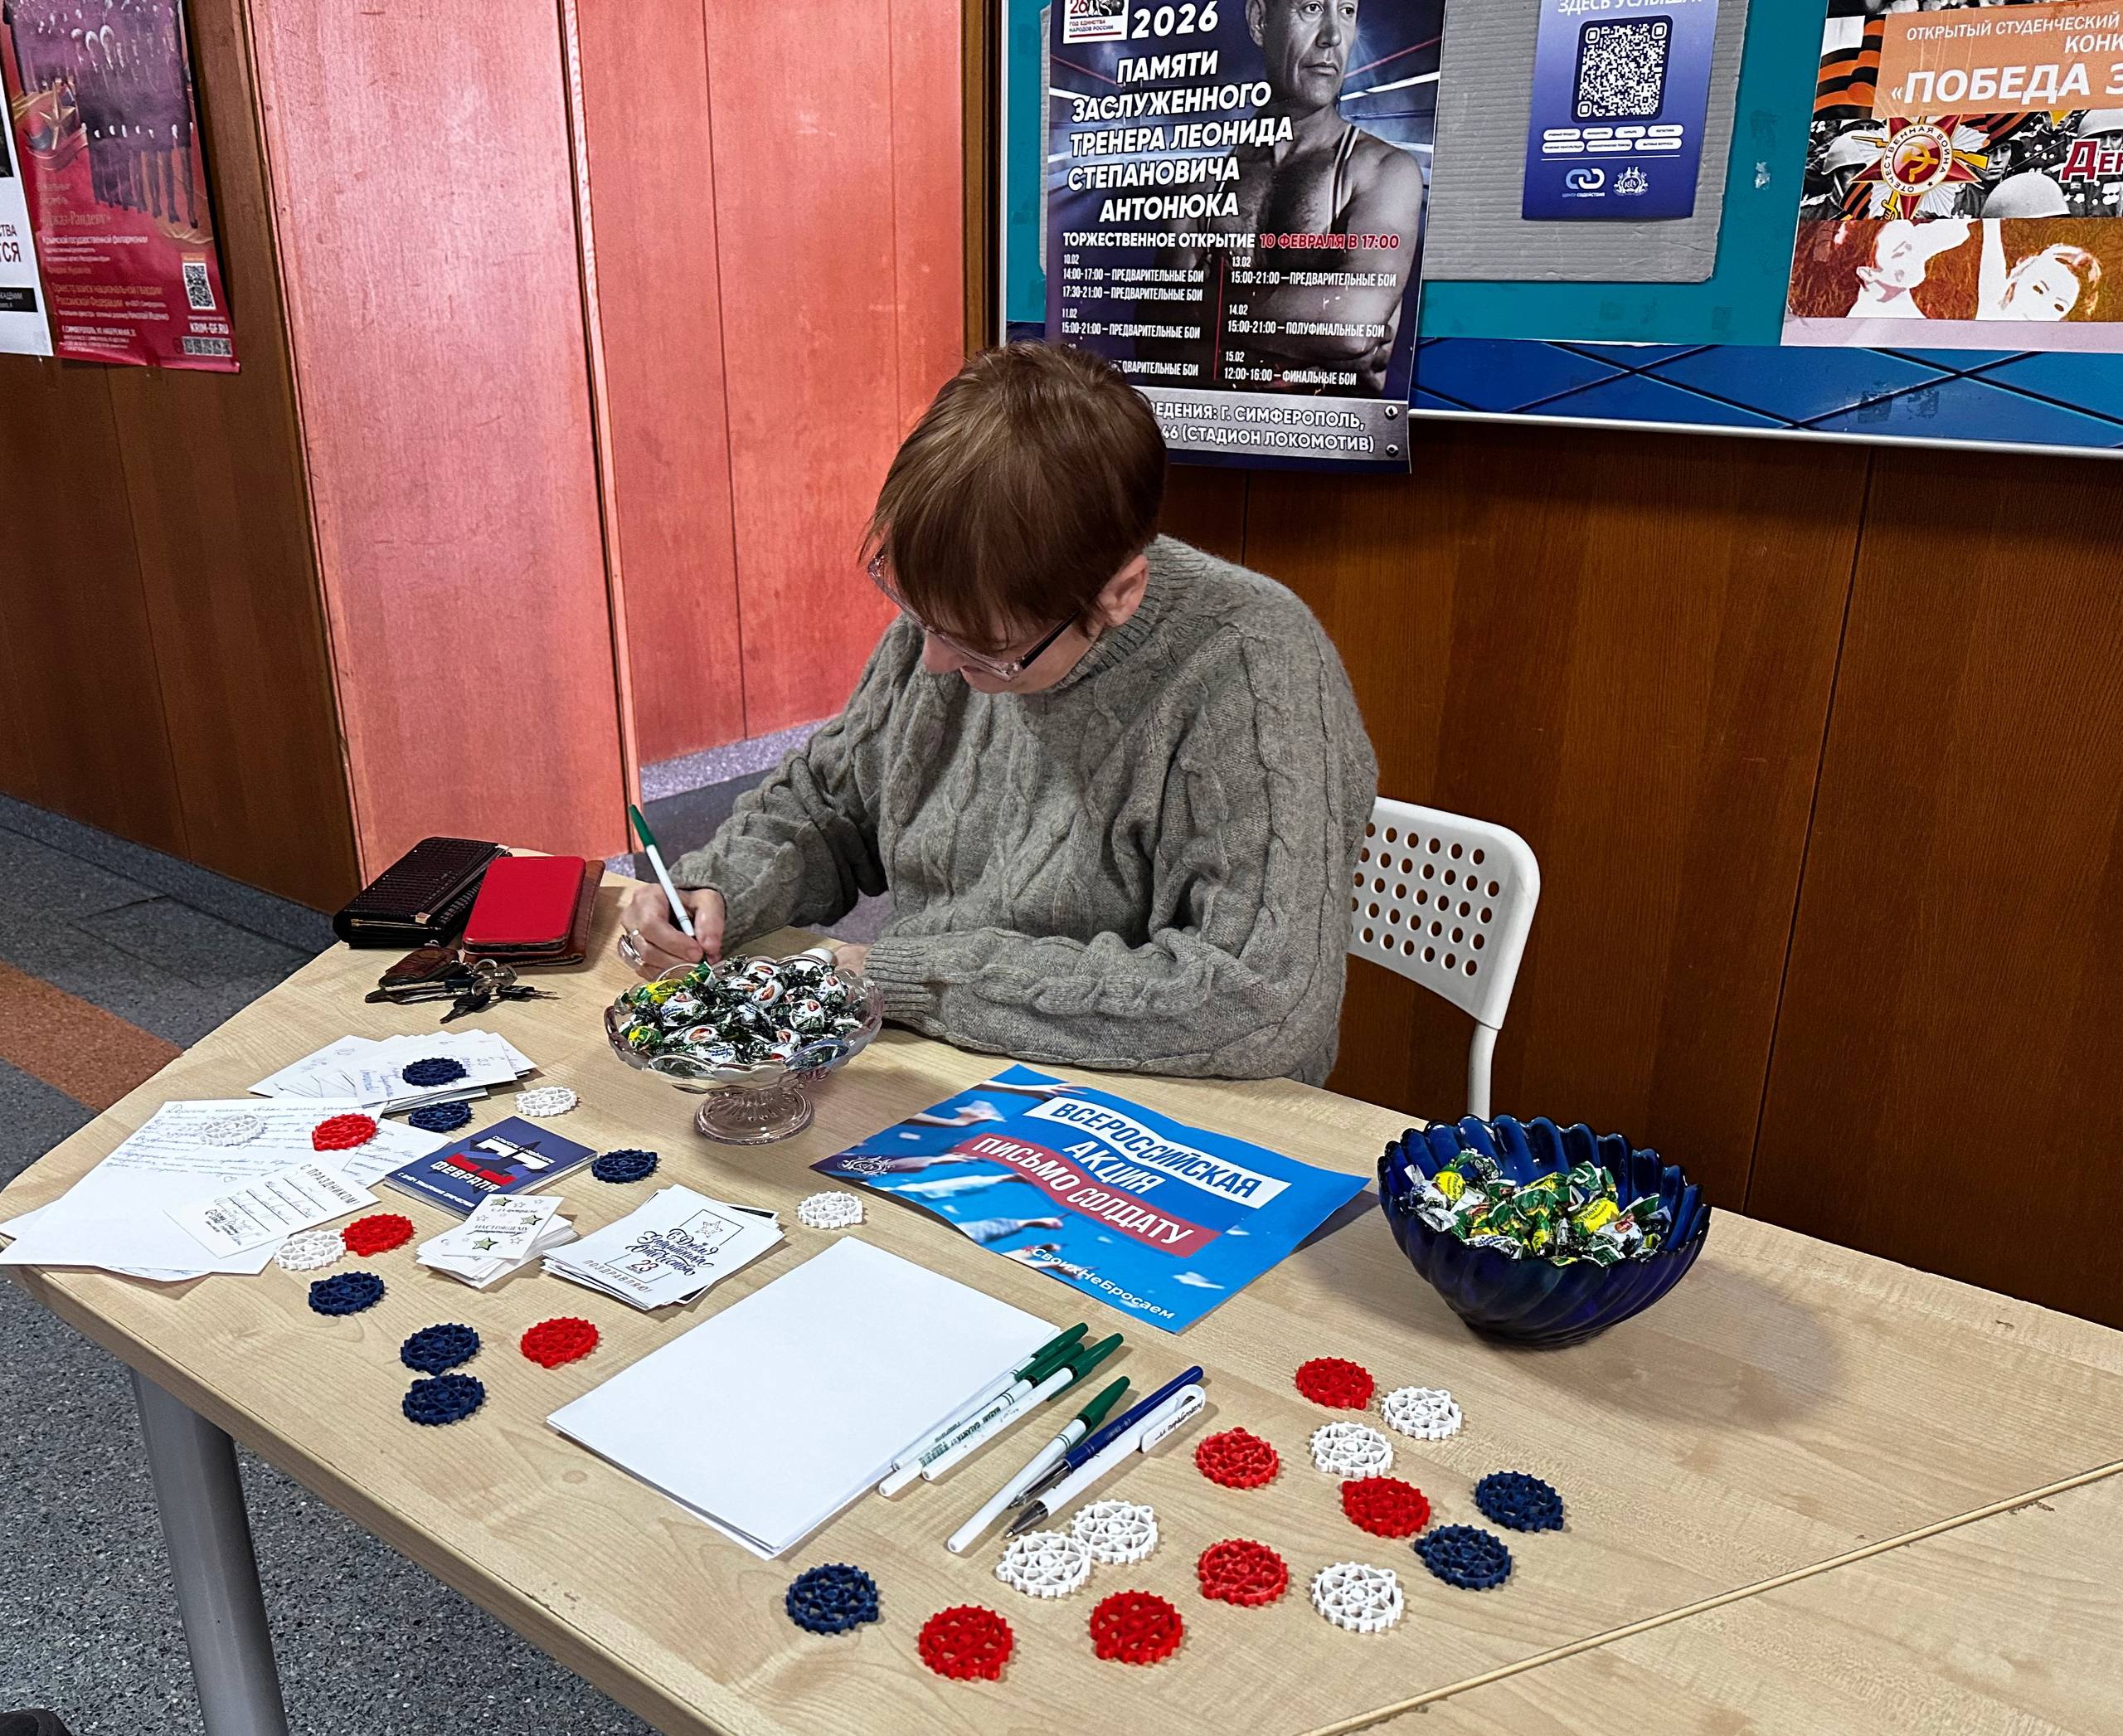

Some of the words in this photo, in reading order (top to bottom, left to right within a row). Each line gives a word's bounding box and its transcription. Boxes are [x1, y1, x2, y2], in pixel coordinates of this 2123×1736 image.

[1131, 1, 1218, 39] 2026
[1907, 22, 1991, 41] ОТКРЫТЫЙ
[1995, 12, 2121, 35] СТУДЕНЧЕСКИЙ
[1116, 50, 1218, 83] ПАМЯТИ
[1891, 63, 2091, 105] «ПОБЕДА
[1071, 81, 1271, 123] ЗАСЛУЖЕННОГО
[1070, 129, 1164, 158] ТРЕНЕРА
[1169, 117, 1294, 150] ЛЕОНИДА
[1884, 126, 1934, 192] ОТЕЧЕСТВЕННАЯ
[1067, 157, 1240, 192] СТЕПАНОВИЧА
[1098, 192, 1239, 222] АНТОНЮКА
[0, 225, 17, 237] ТВА
[1063, 232, 1176, 248] ТОРЖЕСТВЕННОЕ
[1178, 232, 1255, 249] ОТКРЫТИЕ
[1260, 234, 1275, 249] 10
[1277, 233, 1344, 250] ФЕВРАЛЯ
[1347, 235, 1358, 249] В
[1361, 234, 1400, 250] 17:00
[0, 242, 22, 262] СЯ
[1063, 254, 1079, 265] 10.02
[1232, 256, 1251, 268] 13.02
[1063, 268, 1103, 280] 14:00-17:00
[1111, 269, 1186, 283] ПРЕДВАРИТЕЛЬНЫЕ
[1188, 270, 1204, 283] БОИ
[1231, 271, 1280, 284] 15:00-21:00
[1377, 274, 1397, 287] БОИ
[1062, 286, 1103, 299] 17:30-21:00
[1110, 287, 1185, 301] ПРЕДВАРИТЕЛЬНЫЕ
[1186, 289, 1202, 301] БОИ
[1062, 308, 1077, 319] 11.02
[1229, 304, 1248, 315] 14.02
[1062, 322, 1101, 335] 15:00-21:00
[1109, 323, 1183, 338] ПРЕДВАРИТЕЛЬНЫЕ
[1184, 326, 1201, 339] БОИ
[1227, 320, 1276, 333] 15:00-21:00
[1285, 321, 1364, 337] ПОЛУФИНАЛЬНЫЕ
[1366, 324, 1385, 338] БОИ
[1226, 352, 1245, 362] 15.02
[1183, 363, 1199, 377] БОИ
[1224, 367, 1273, 381] 12:00-16:00
[1282, 371, 1337, 385] ФИНАЛЬНЫЕ
[1338, 372, 1357, 386] БОИ
[1220, 406, 1231, 421] Г.
[1234, 406, 1366, 431] СИМФЕРОПОЛЬ,
[1182, 424, 1261, 445] (СТАДИОН
[1264, 430, 1376, 453] ЛОКОМОТИВ)
[1050, 1102, 1263, 1199] ВСЕРОССИЙСКАЯ
[430, 1160, 502, 1193] ФЕВРАЛЯ
[1062, 1140, 1166, 1195] АКЦИЯ
[306, 1168, 361, 1205] ПРАЗДНИКОМ!
[972, 1136, 1081, 1192] ПИСЬМО
[1066, 1186, 1196, 1245] СОЛДАТУ
[583, 1259, 653, 1294] ПОЗДРАВЛЯЮ!
[631, 1259, 659, 1272] 23
